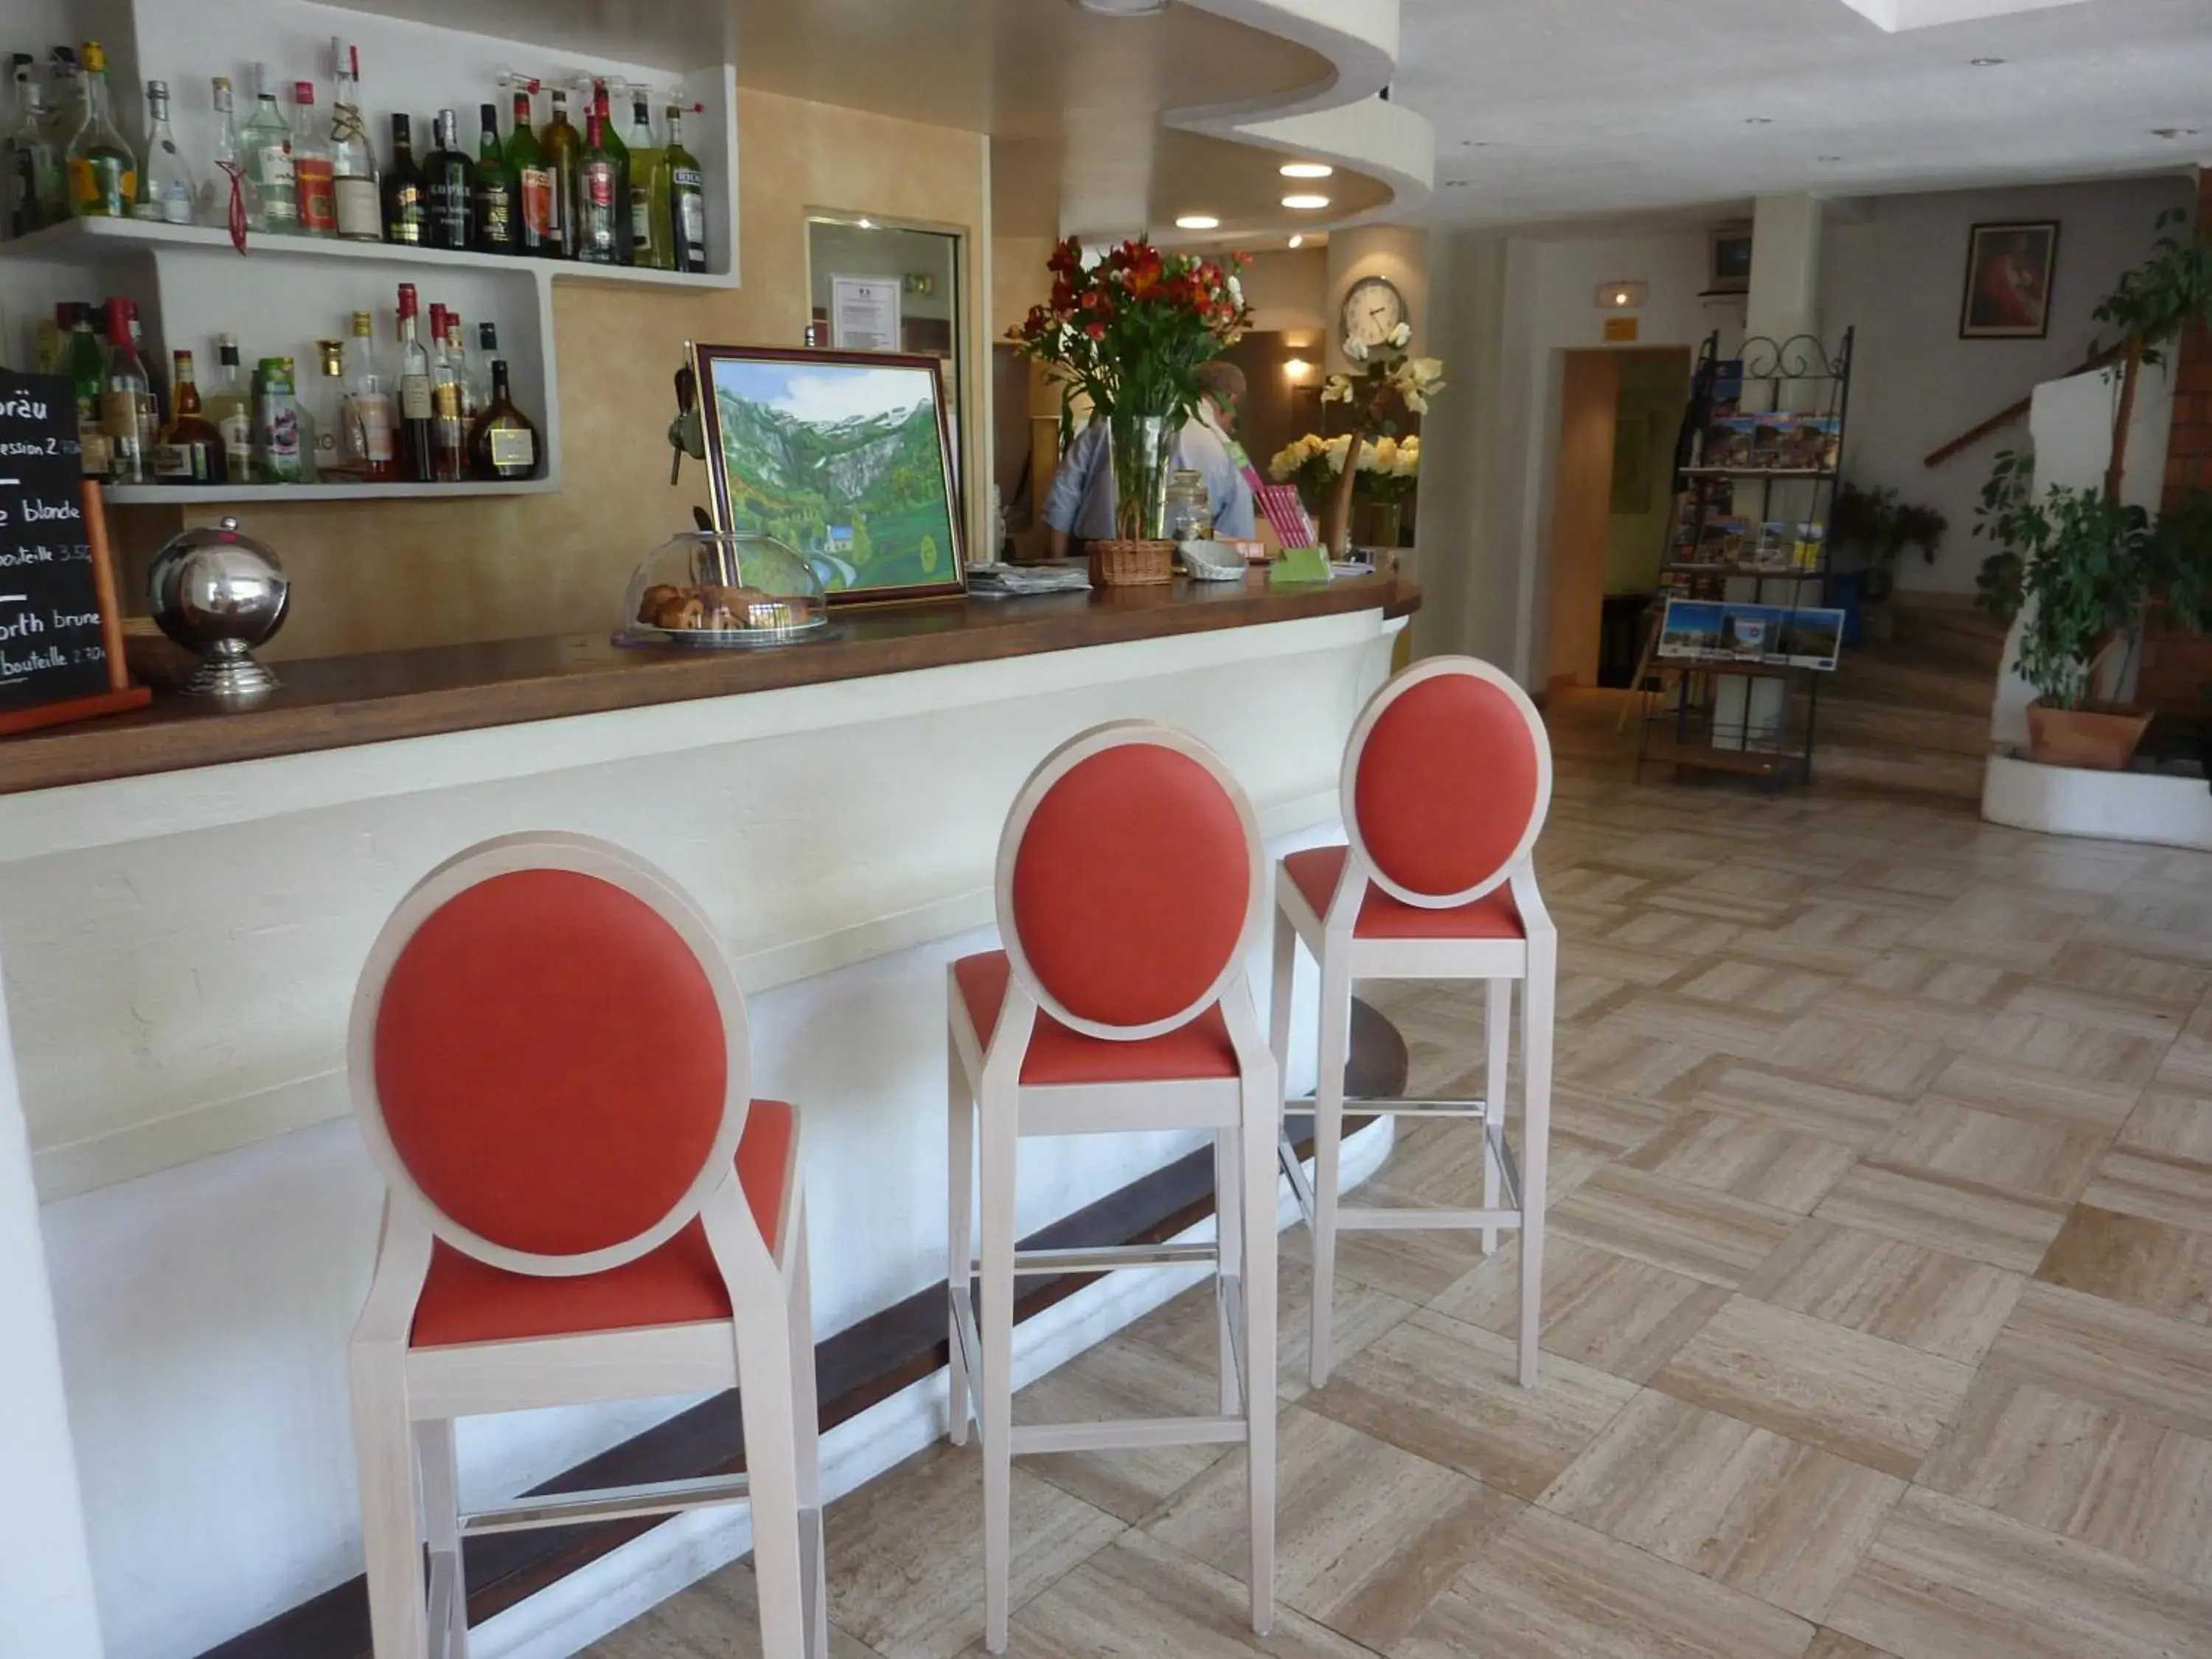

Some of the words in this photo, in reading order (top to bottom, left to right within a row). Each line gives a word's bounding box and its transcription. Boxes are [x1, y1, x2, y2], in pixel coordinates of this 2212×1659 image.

[22, 498, 80, 522] blonde
[52, 608, 101, 628] brune
[0, 645, 68, 675] bouteille
